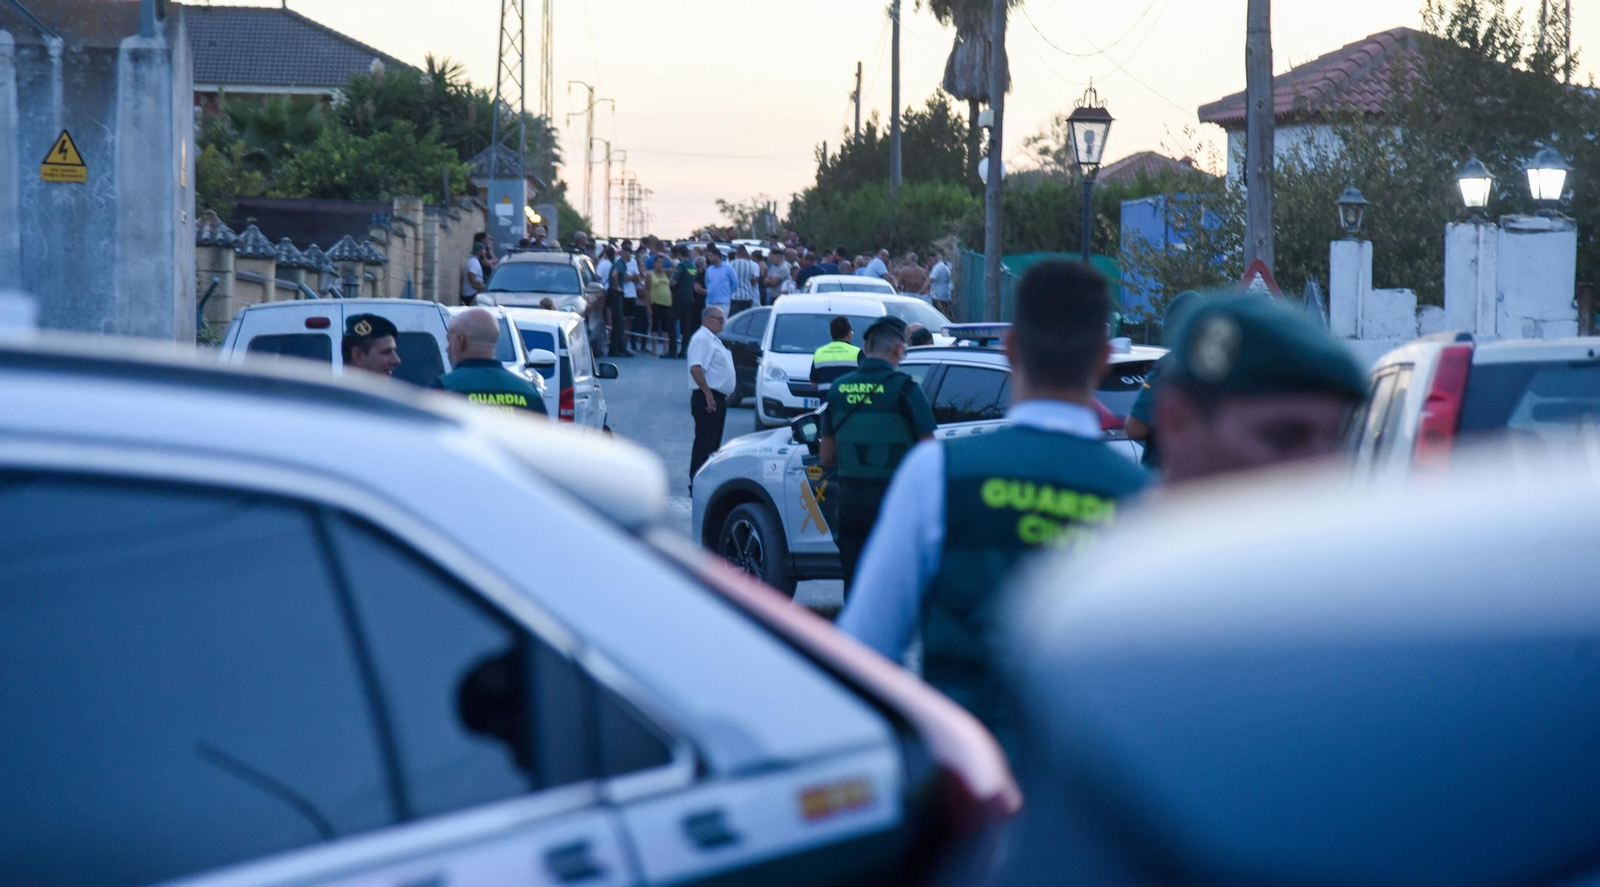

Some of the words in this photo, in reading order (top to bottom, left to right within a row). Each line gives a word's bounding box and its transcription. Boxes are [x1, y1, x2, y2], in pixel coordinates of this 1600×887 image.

[1120, 375, 1147, 385] GU
[468, 393, 527, 407] GUARDIA
[979, 477, 1117, 526] GUARDI
